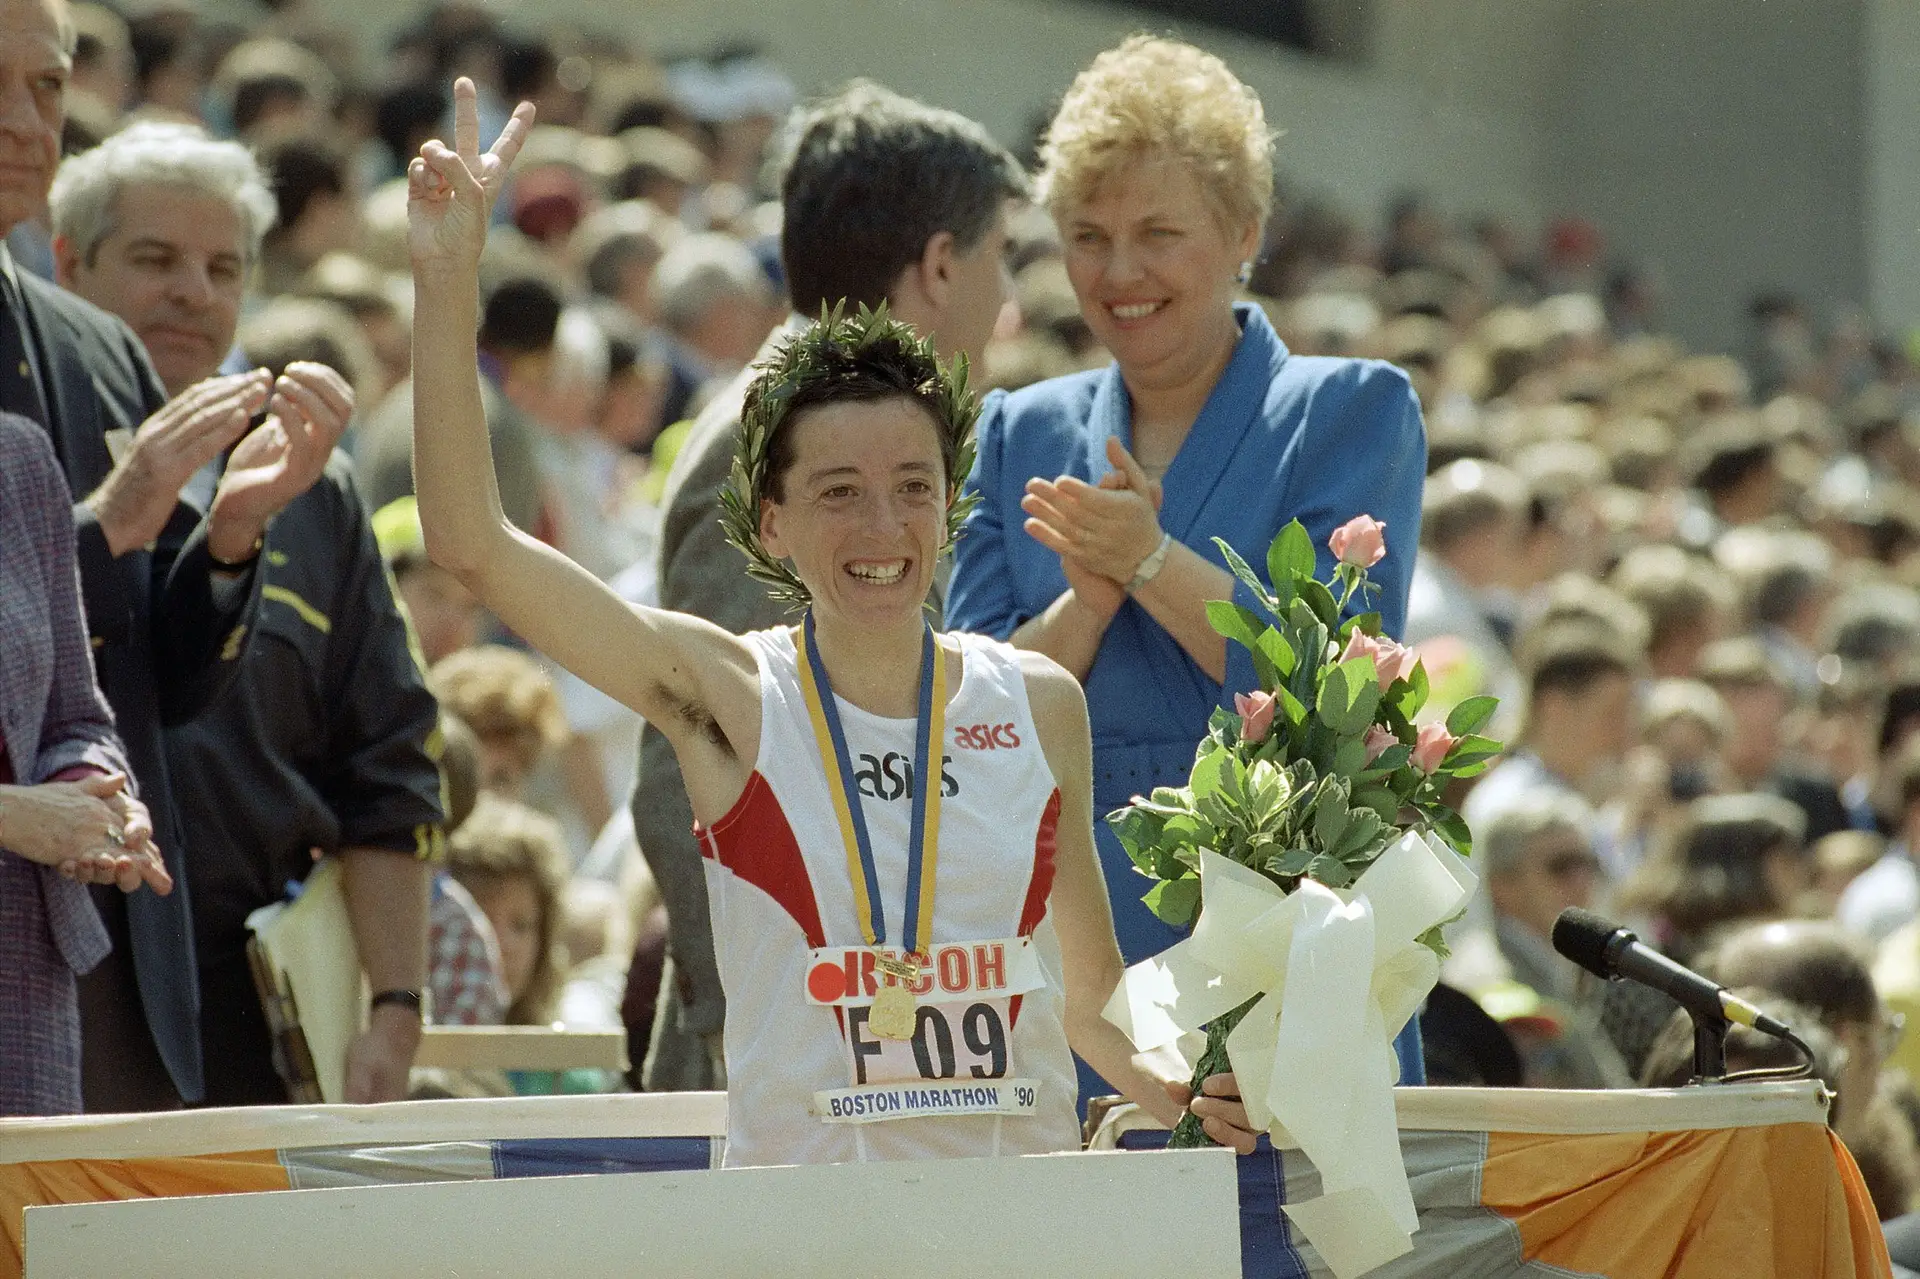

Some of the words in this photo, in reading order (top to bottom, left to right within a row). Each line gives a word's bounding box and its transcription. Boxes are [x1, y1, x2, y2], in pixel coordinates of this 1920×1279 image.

[954, 722, 1021, 751] asics
[855, 751, 960, 801] asis
[831, 1091, 901, 1117] BOSTON
[904, 1087, 999, 1109] MARATHON
[1014, 1087, 1034, 1107] '90
